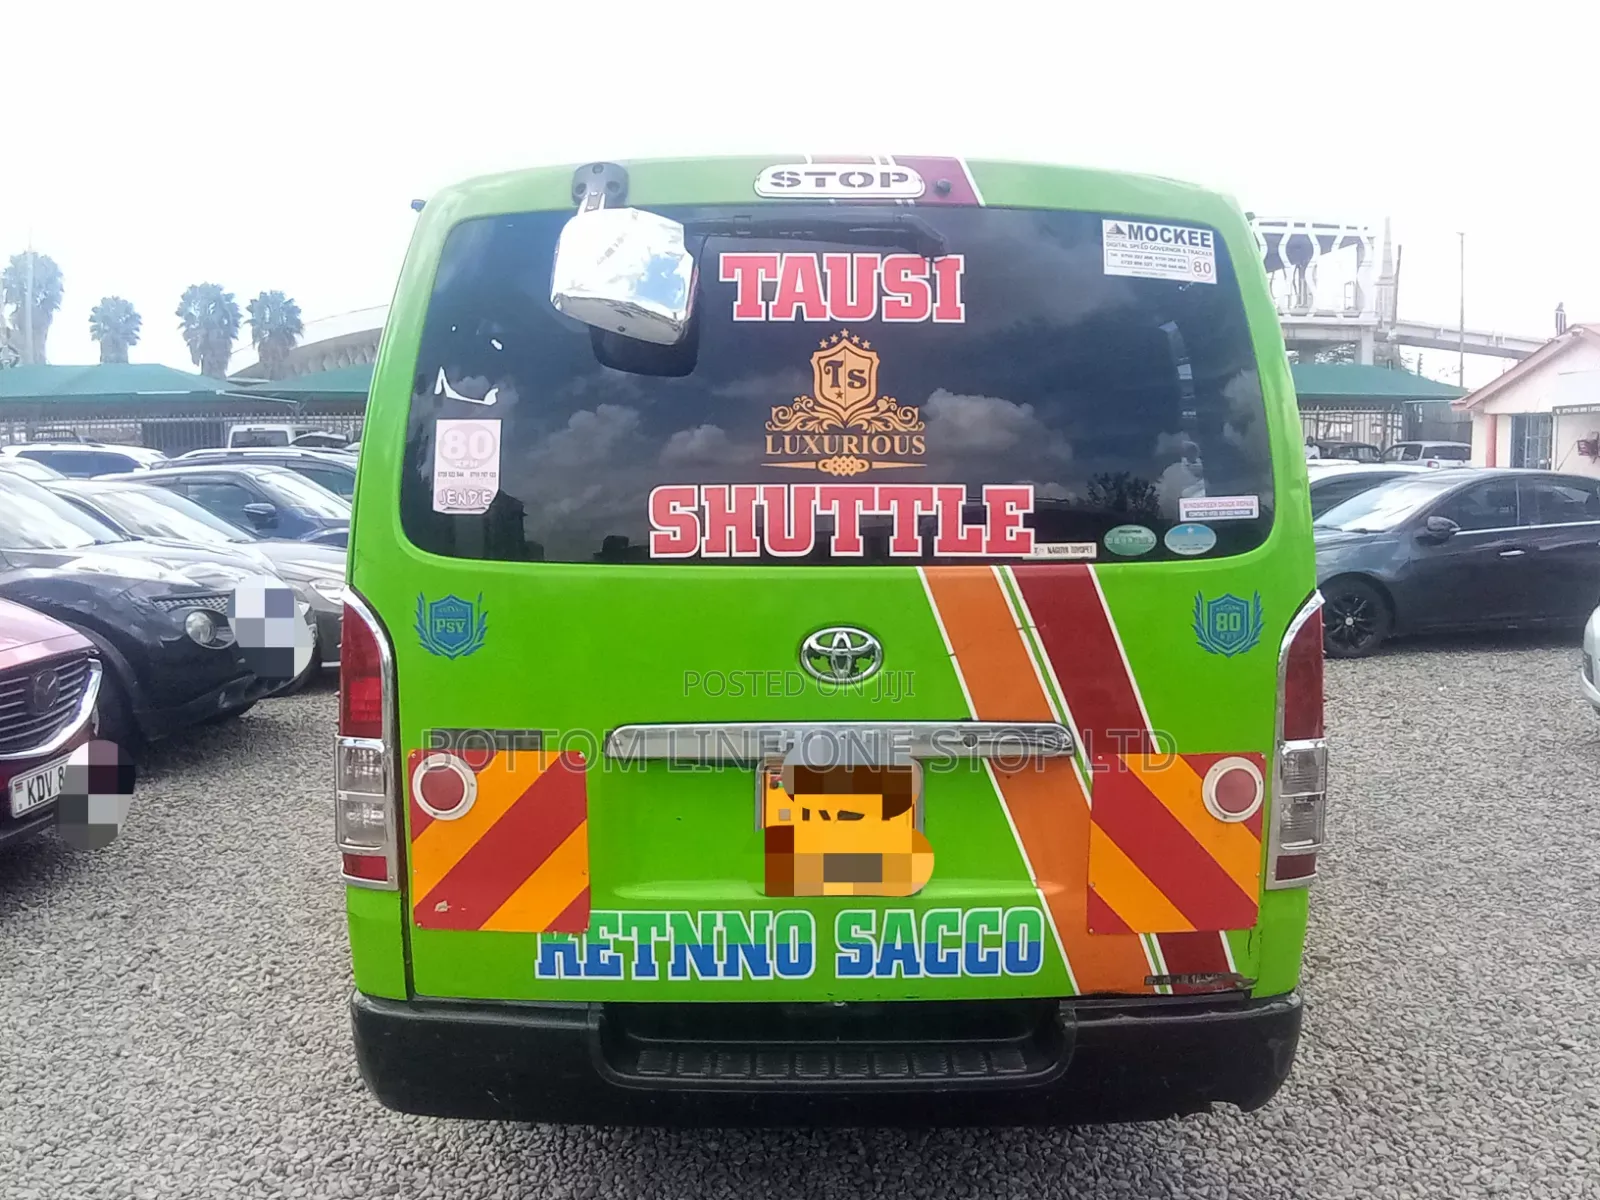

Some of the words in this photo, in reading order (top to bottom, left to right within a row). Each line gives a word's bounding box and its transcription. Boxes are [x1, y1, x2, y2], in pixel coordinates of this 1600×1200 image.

[770, 171, 909, 188] STOP
[1127, 224, 1212, 248] MOCKEE
[1106, 241, 1128, 249] DIGITAL
[1150, 244, 1182, 254] GOVERNOR
[1188, 248, 1213, 257] TRACKER
[1193, 260, 1212, 274] 80
[719, 252, 966, 323] TAUSI
[441, 429, 496, 460] 80
[764, 434, 926, 456] LUXURIOUS
[649, 484, 1036, 559] SHUTTLE
[1216, 612, 1240, 632] 80
[27, 769, 53, 806] KDV
[834, 906, 1046, 978] SACCO
